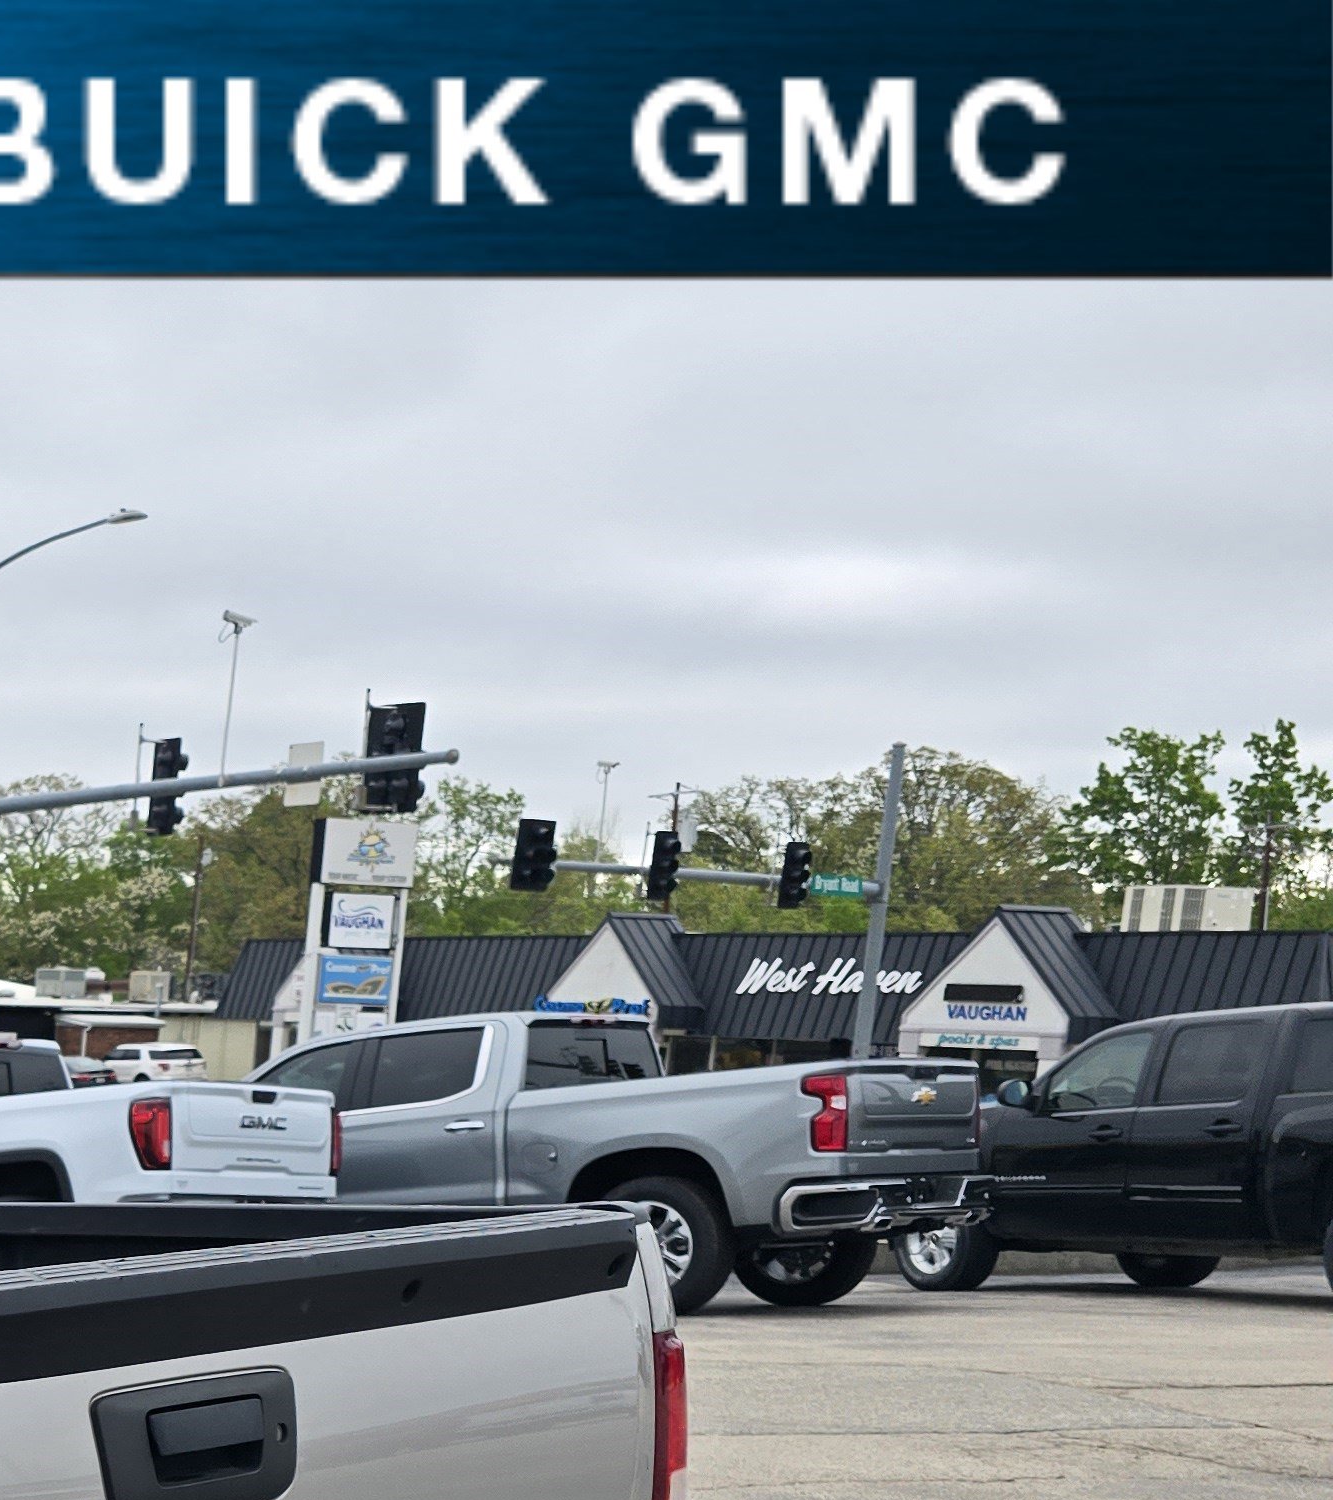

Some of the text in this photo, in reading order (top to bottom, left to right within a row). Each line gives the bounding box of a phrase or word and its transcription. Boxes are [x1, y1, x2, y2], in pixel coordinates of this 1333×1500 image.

[735, 957, 816, 995] West
[947, 1004, 1028, 1022] VAUGHAN
[240, 1115, 288, 1131] GMC
